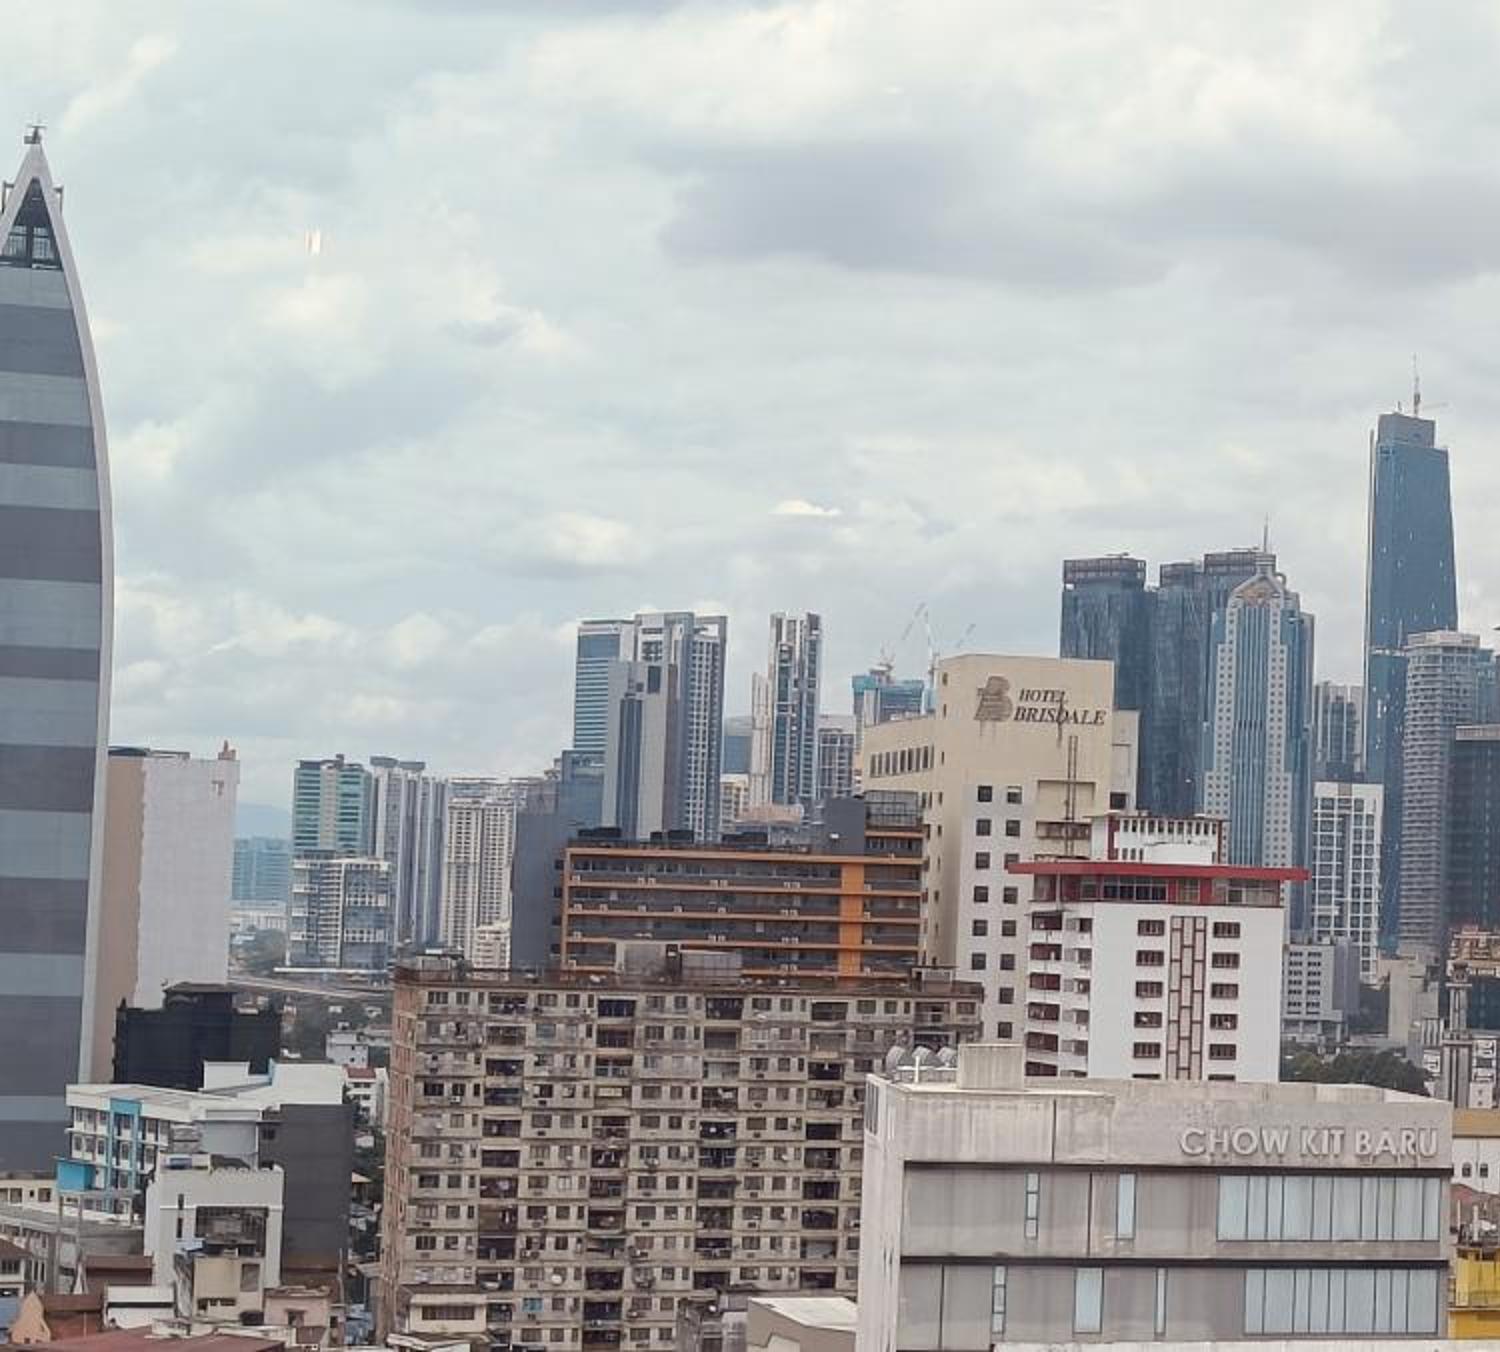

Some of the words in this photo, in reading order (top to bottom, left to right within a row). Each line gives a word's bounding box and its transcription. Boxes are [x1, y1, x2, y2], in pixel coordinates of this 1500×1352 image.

[1019, 688, 1067, 703] HOTEL
[1013, 706, 1106, 725] BRISDALE
[1180, 1127, 1290, 1157] CHOW
[1300, 1127, 1345, 1157] KIT
[1354, 1127, 1438, 1158] BARU
